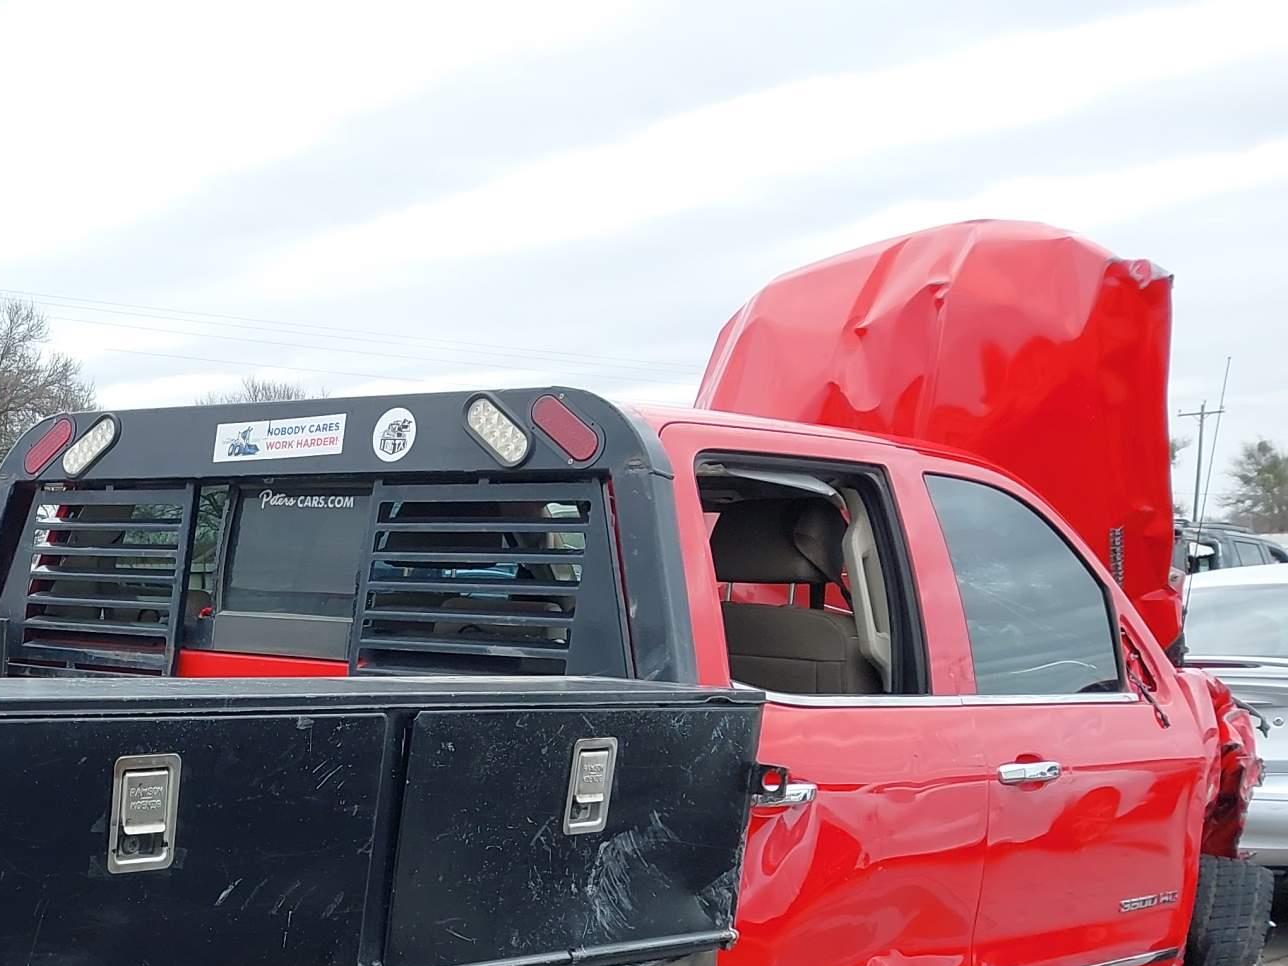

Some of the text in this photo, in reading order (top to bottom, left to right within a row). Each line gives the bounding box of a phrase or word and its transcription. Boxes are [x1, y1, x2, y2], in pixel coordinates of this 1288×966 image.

[267, 422, 341, 437] NOBODY CARES
[266, 436, 339, 451] WORK HARDER!
[259, 489, 354, 509] Peters CARS.COM
